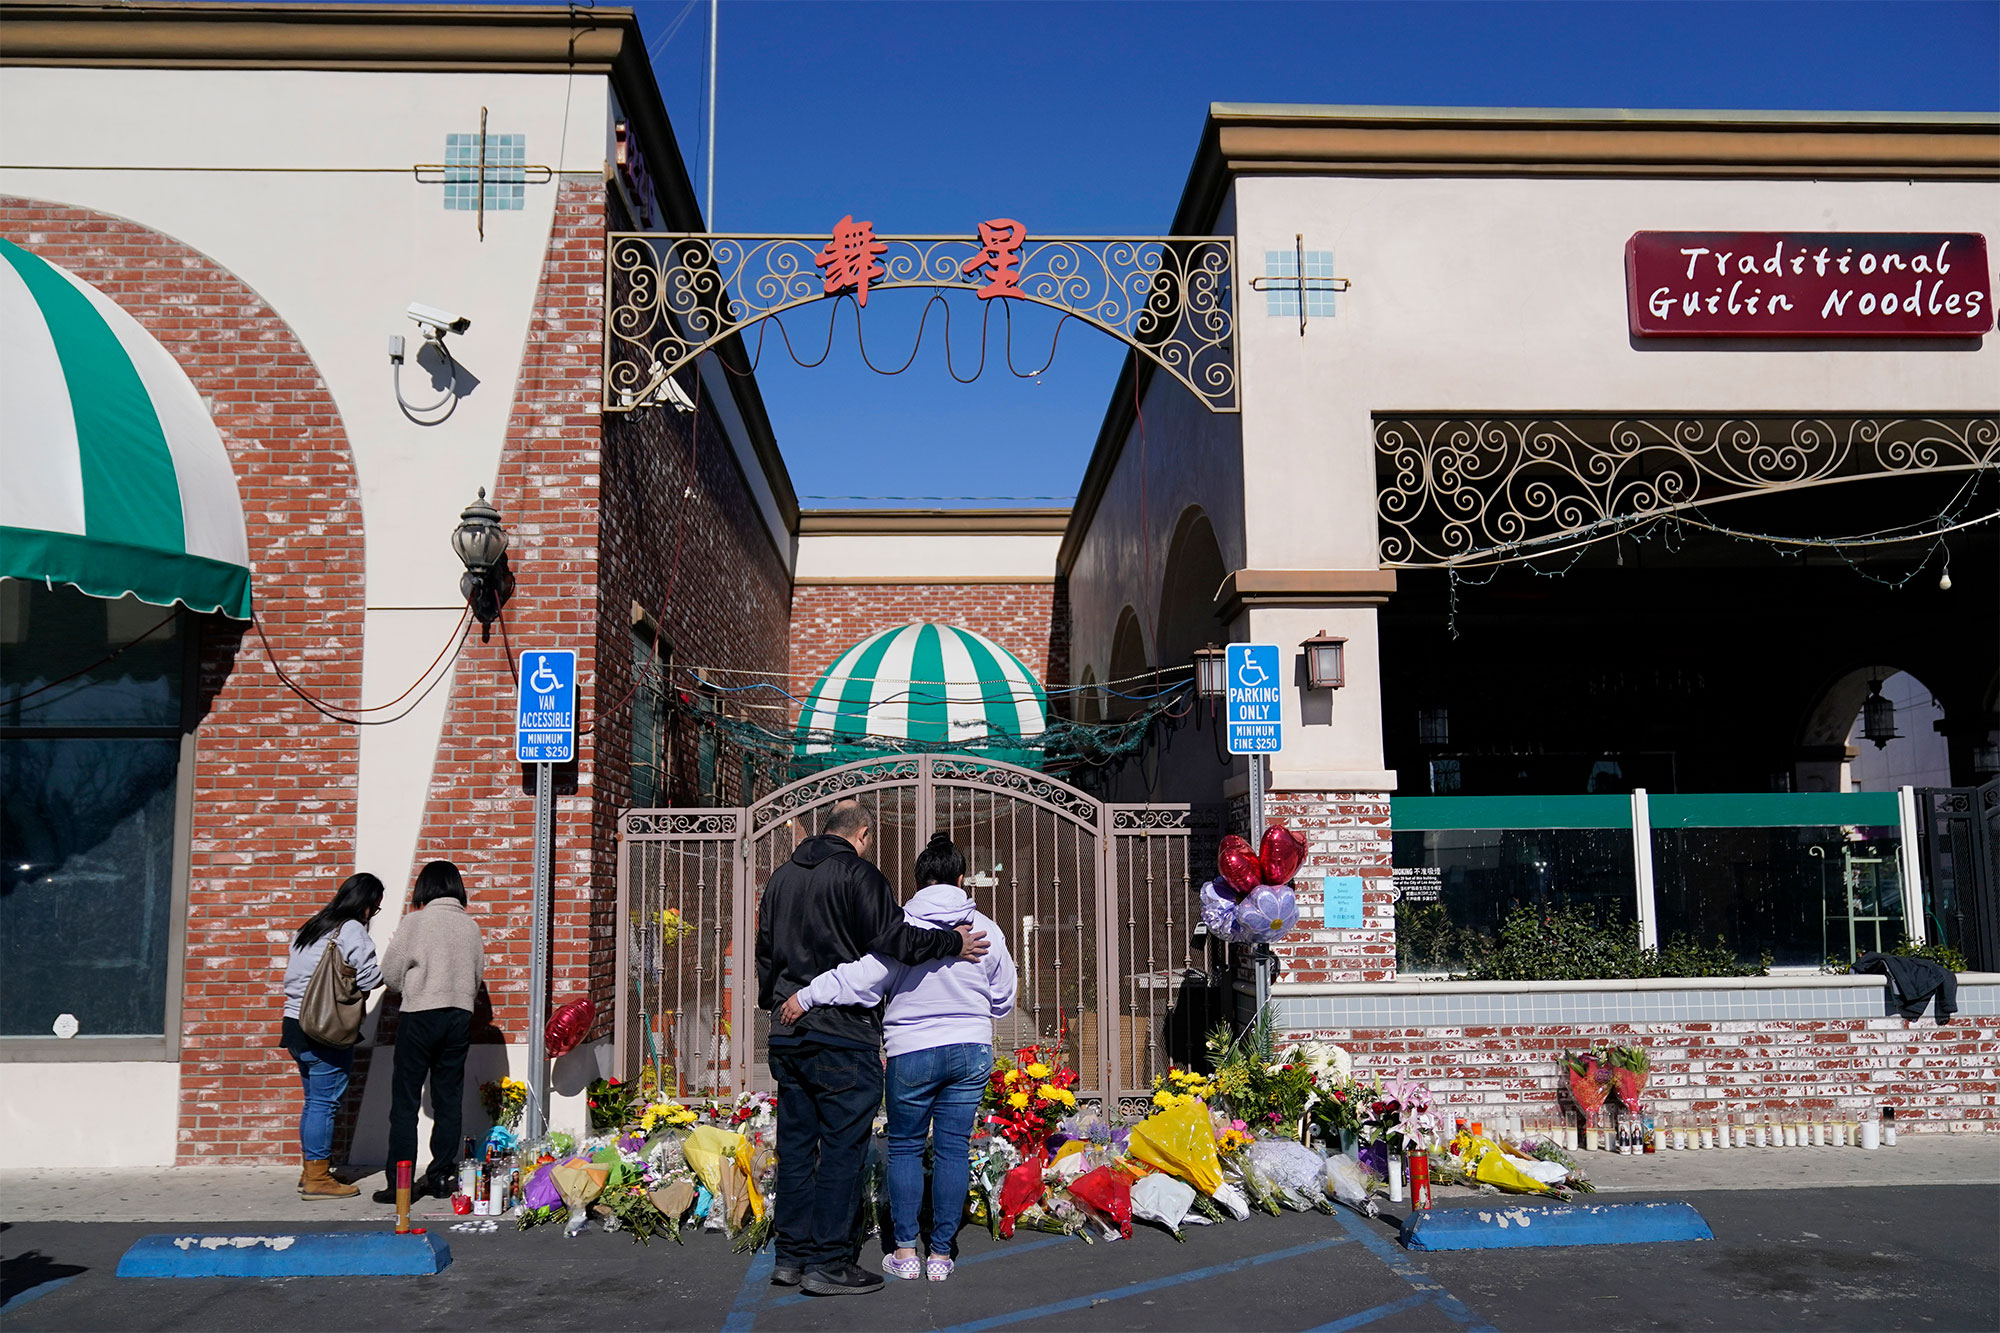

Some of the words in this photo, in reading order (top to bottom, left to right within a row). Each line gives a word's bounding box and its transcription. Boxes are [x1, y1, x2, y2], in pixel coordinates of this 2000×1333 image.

[1680, 240, 1951, 280] Traditional
[1649, 280, 1793, 320] Guilin
[1821, 280, 1984, 319] Noodles
[538, 695, 555, 710] VAN
[1230, 687, 1279, 703] PARKING
[521, 712, 570, 728] ACCESSIBLE
[1239, 705, 1270, 720] ONLY
[1236, 725, 1275, 737] MINIMUM
[527, 733, 563, 745] MINIMUM
[1234, 738, 1253, 749] FINE
[1256, 737, 1278, 750] $250
[521, 746, 539, 757] FINE
[545, 746, 569, 757] $250
